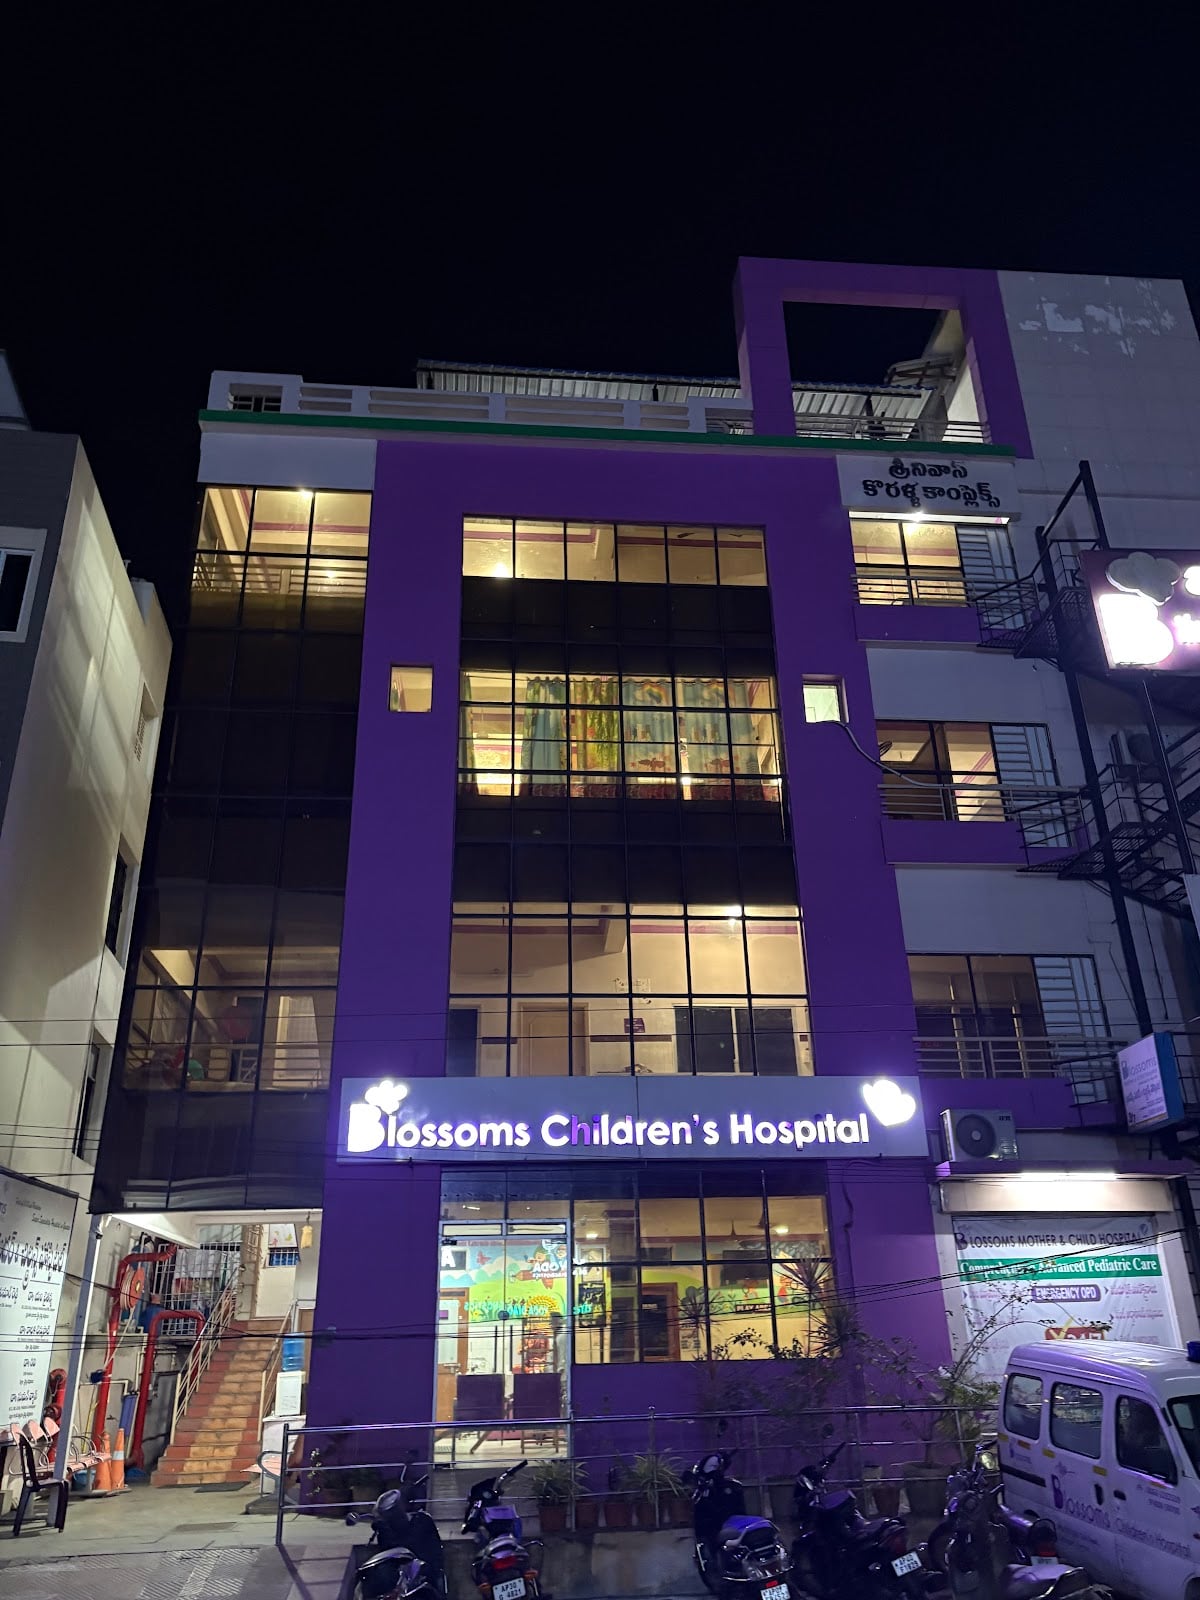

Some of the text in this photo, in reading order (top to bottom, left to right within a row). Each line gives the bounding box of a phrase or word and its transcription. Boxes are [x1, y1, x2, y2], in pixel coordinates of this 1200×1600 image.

[347, 1102, 869, 1153] Blossoms Children's Hospital
[954, 1233, 1016, 1250] BLOSSOMS
[1018, 1234, 1058, 1247] MOTHER
[1059, 1235, 1066, 1246] &
[1068, 1233, 1097, 1246] CHILD
[1088, 1257, 1130, 1273] Pediatric
[1132, 1256, 1157, 1271] Care
[1080, 1286, 1097, 1299] OPD
